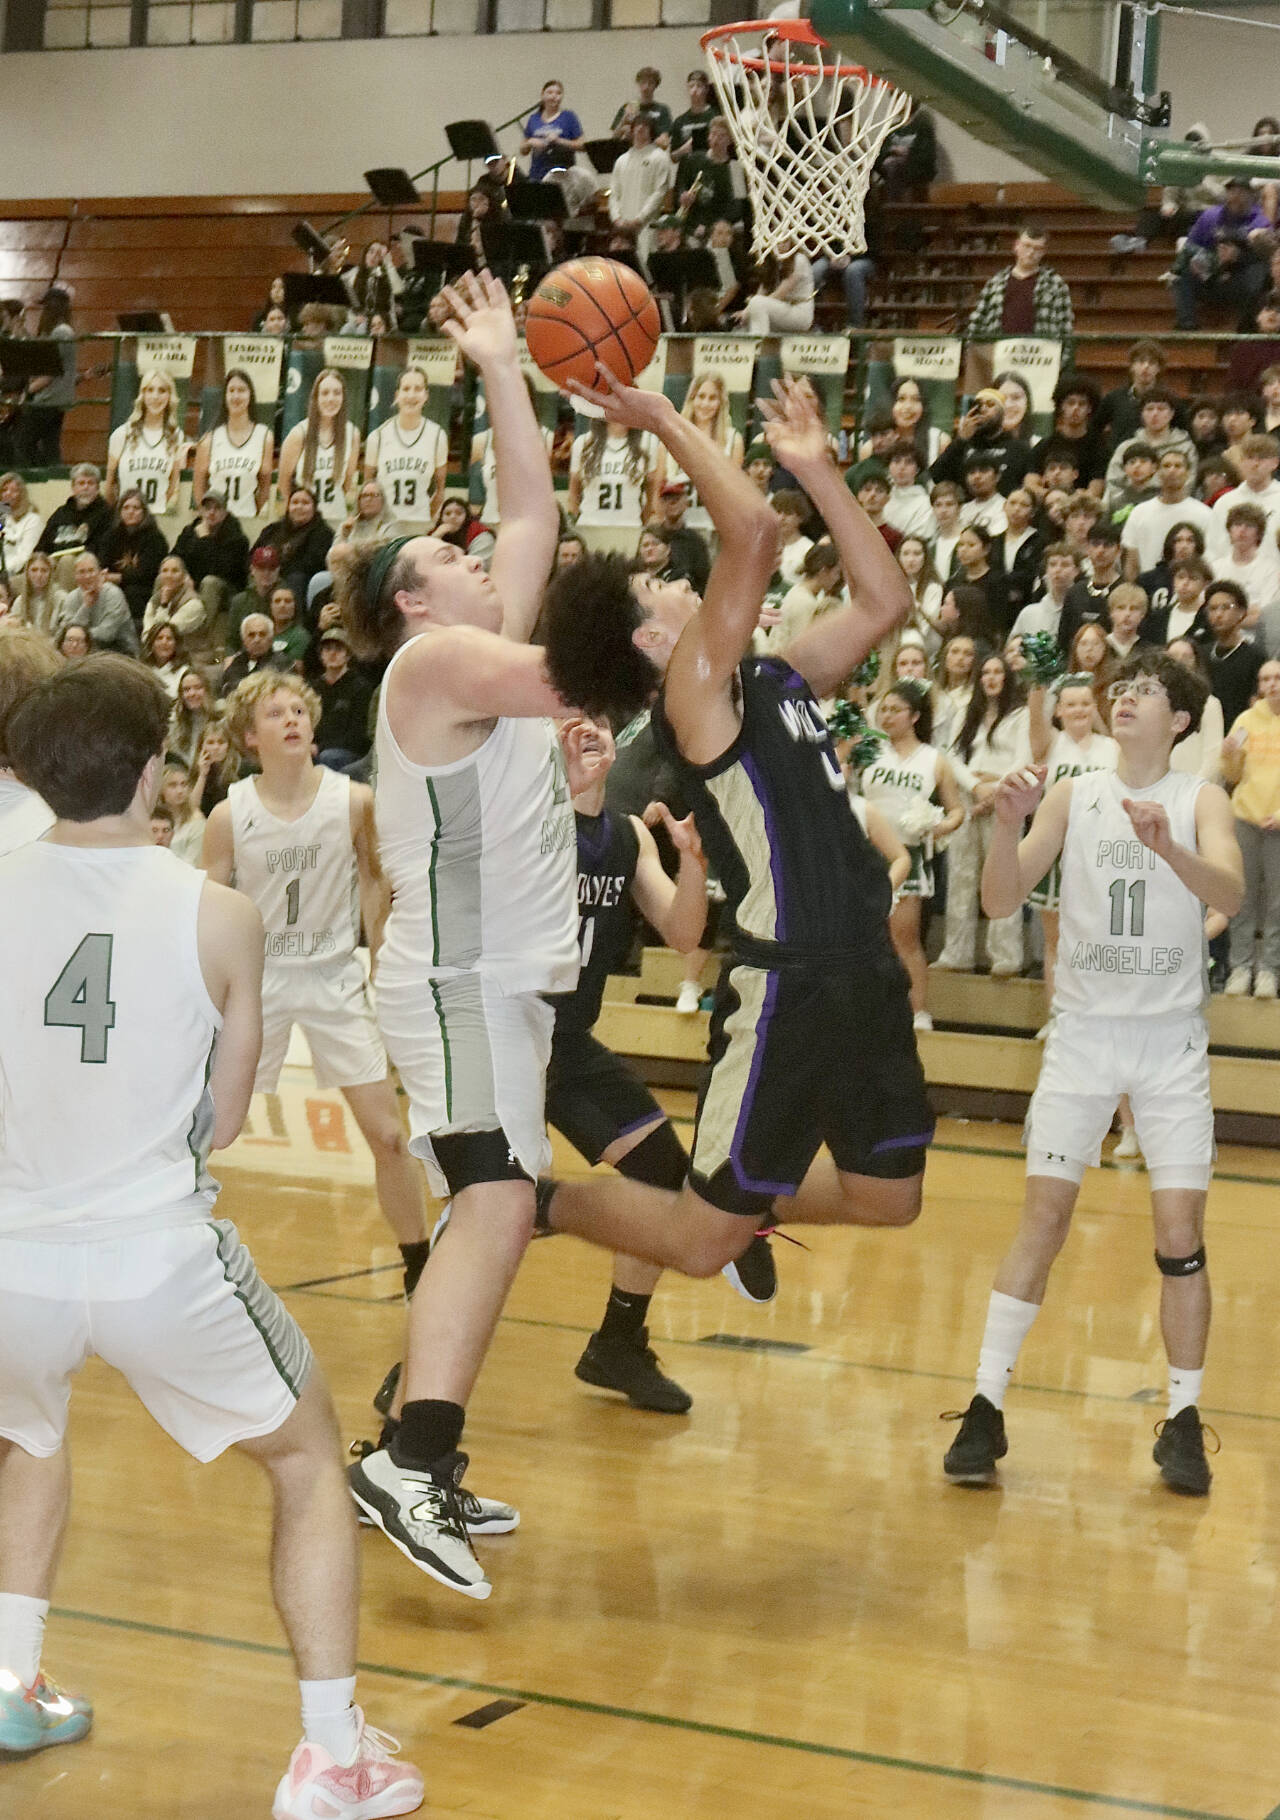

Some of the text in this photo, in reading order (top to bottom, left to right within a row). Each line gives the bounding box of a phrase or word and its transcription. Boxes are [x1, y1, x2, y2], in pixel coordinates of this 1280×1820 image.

[128, 456, 169, 474] RIDERS
[215, 455, 257, 473] RIDERS
[385, 456, 429, 474] RIDERS
[314, 477, 336, 504] 12
[392, 478, 417, 506] 13
[598, 483, 623, 509] 21
[778, 698, 830, 743] WOL
[871, 766, 925, 792] PAHS
[265, 843, 322, 874] PORT
[285, 877, 300, 926] 1
[577, 873, 626, 907] OLVES
[1108, 878, 1146, 937] 11
[1071, 940, 1184, 976] ANGELES
[43, 932, 117, 1064] 4
